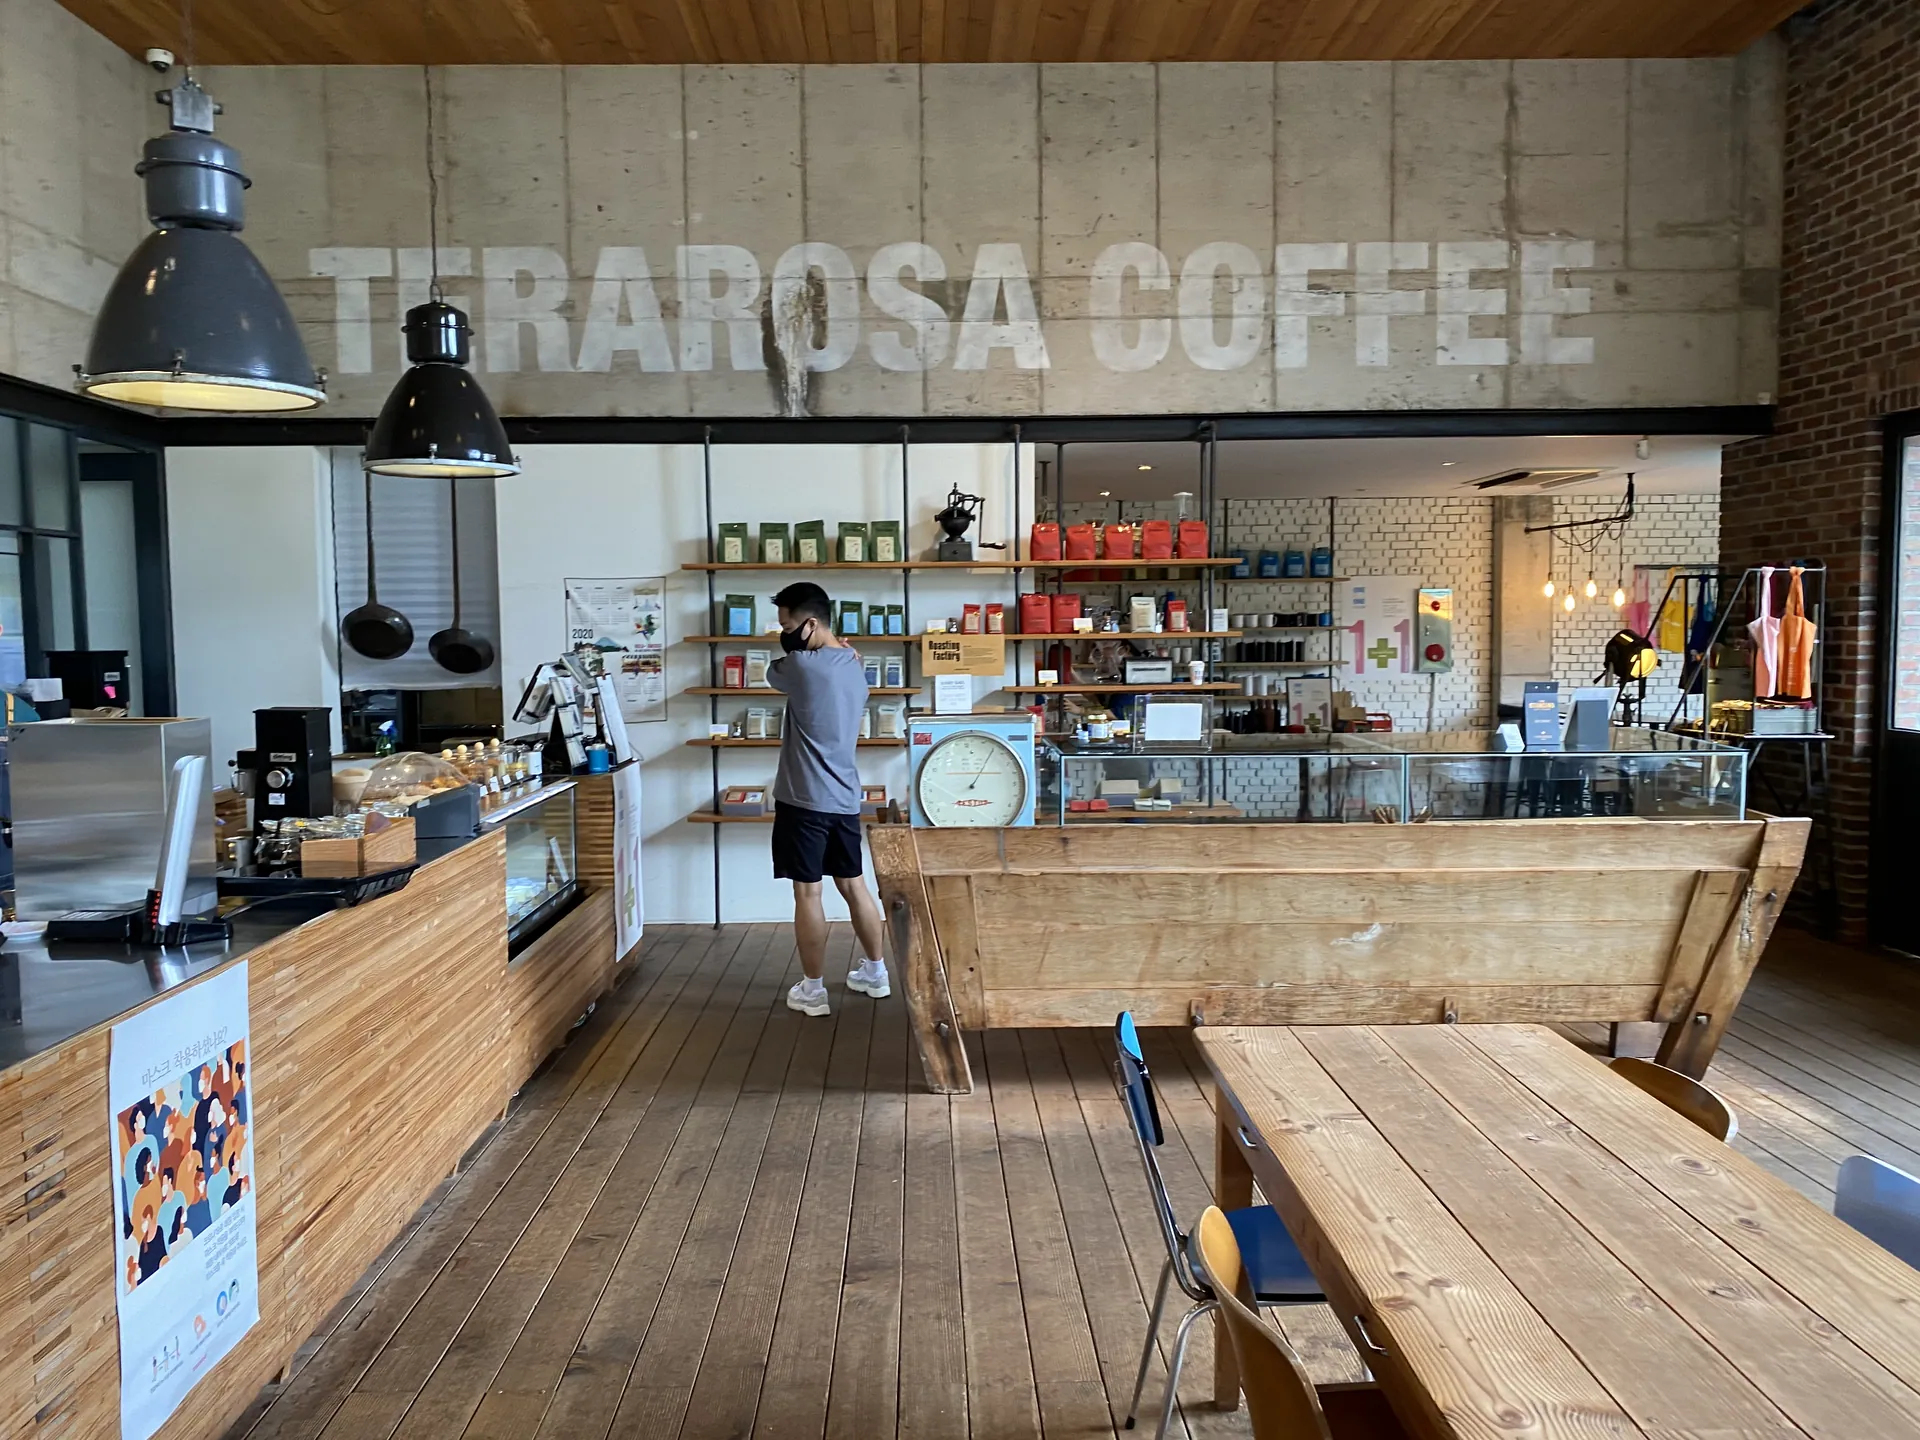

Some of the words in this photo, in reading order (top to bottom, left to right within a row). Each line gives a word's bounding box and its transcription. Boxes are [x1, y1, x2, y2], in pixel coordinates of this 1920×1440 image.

[1090, 241, 1595, 372] COFFEE
[572, 628, 594, 639] 2020
[929, 640, 960, 651] Roasting
[142, 1060, 171, 1088] 마스크
